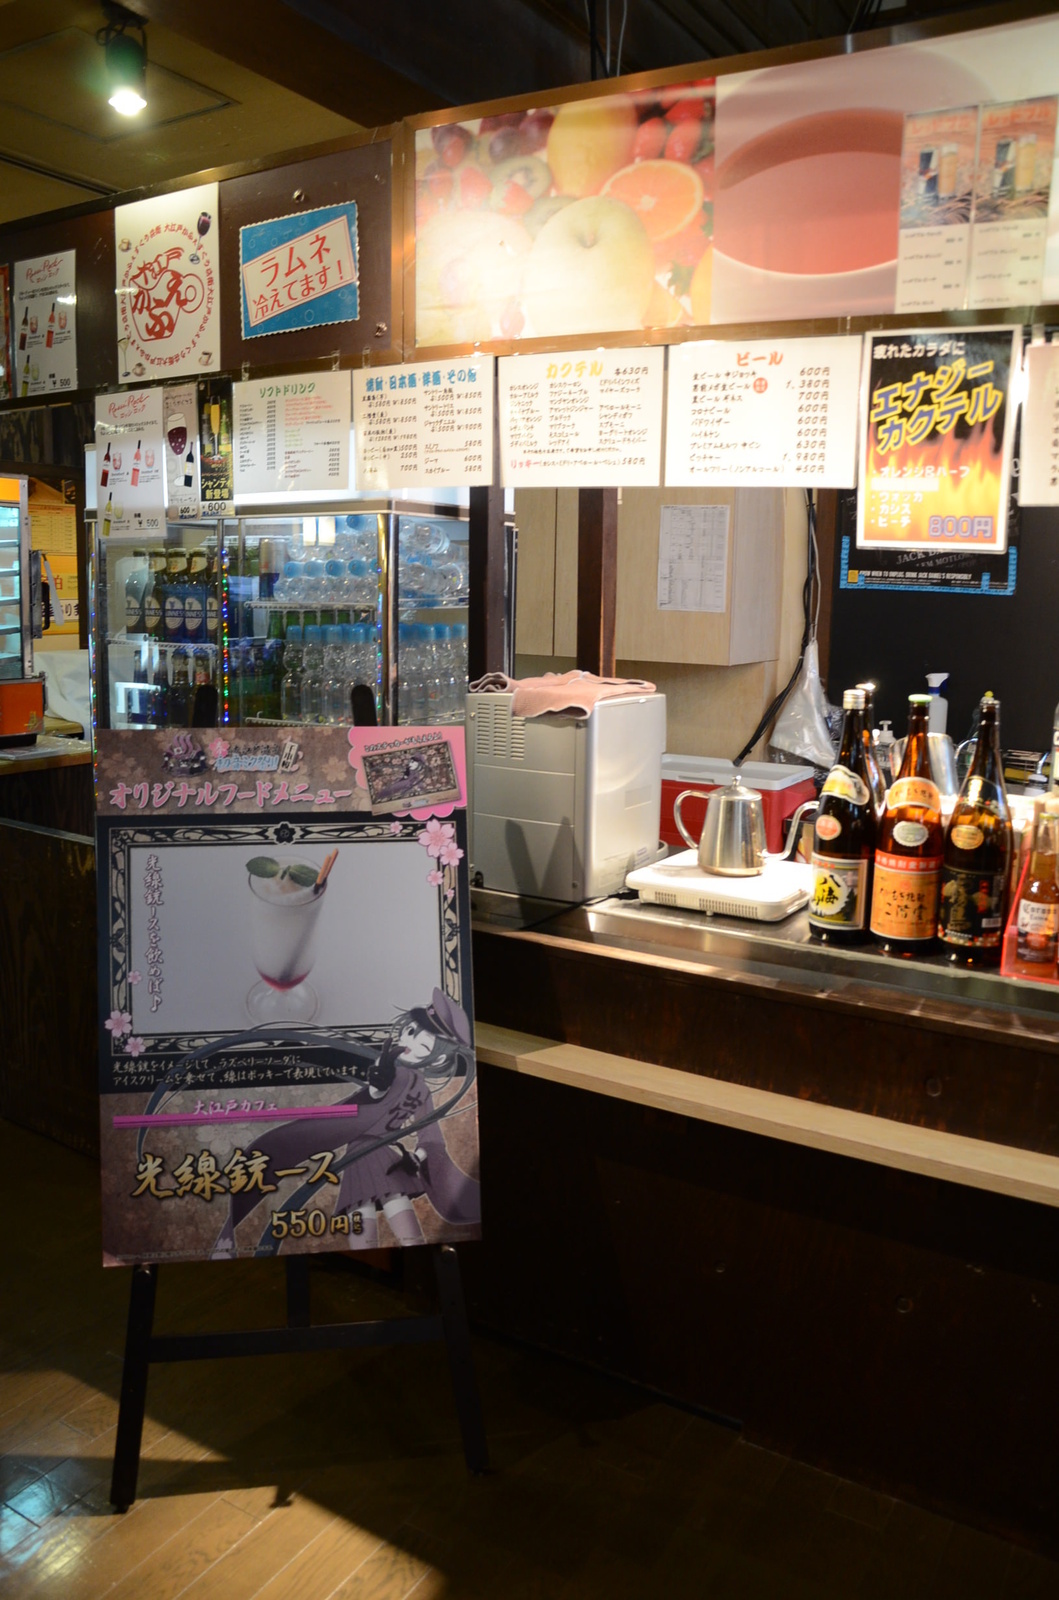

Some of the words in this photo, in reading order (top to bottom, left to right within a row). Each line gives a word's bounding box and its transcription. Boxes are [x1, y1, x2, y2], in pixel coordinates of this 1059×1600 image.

[260, 234, 331, 287] ラムネ
[872, 341, 966, 359] 疲れたカラダに
[737, 350, 783, 367] ビール
[546, 360, 604, 380] カクテル
[799, 367, 830, 377] 600円
[60, 378, 71, 387] 500
[260, 382, 316, 398] ソフトドリンク
[798, 391, 829, 401] 700円
[871, 357, 994, 422] エナジー
[691, 406, 731, 416] コロナビール
[797, 403, 829, 413] 600円
[797, 416, 828, 426] 600円
[877, 382, 1003, 455] カクテル
[796, 428, 828, 438] 600円
[796, 440, 827, 450] 630円
[795, 464, 825, 475] 450円
[180, 505, 191, 514] 600
[207, 501, 227, 512] 600
[879, 503, 912, 515] カシス
[147, 518, 159, 528] 500
[928, 515, 994, 538] 800円
[109, 782, 352, 809] オリジナルフードメニュー
[192, 1099, 278, 1116] 大江戸カフェ
[131, 1148, 341, 1201] 光線銃ース
